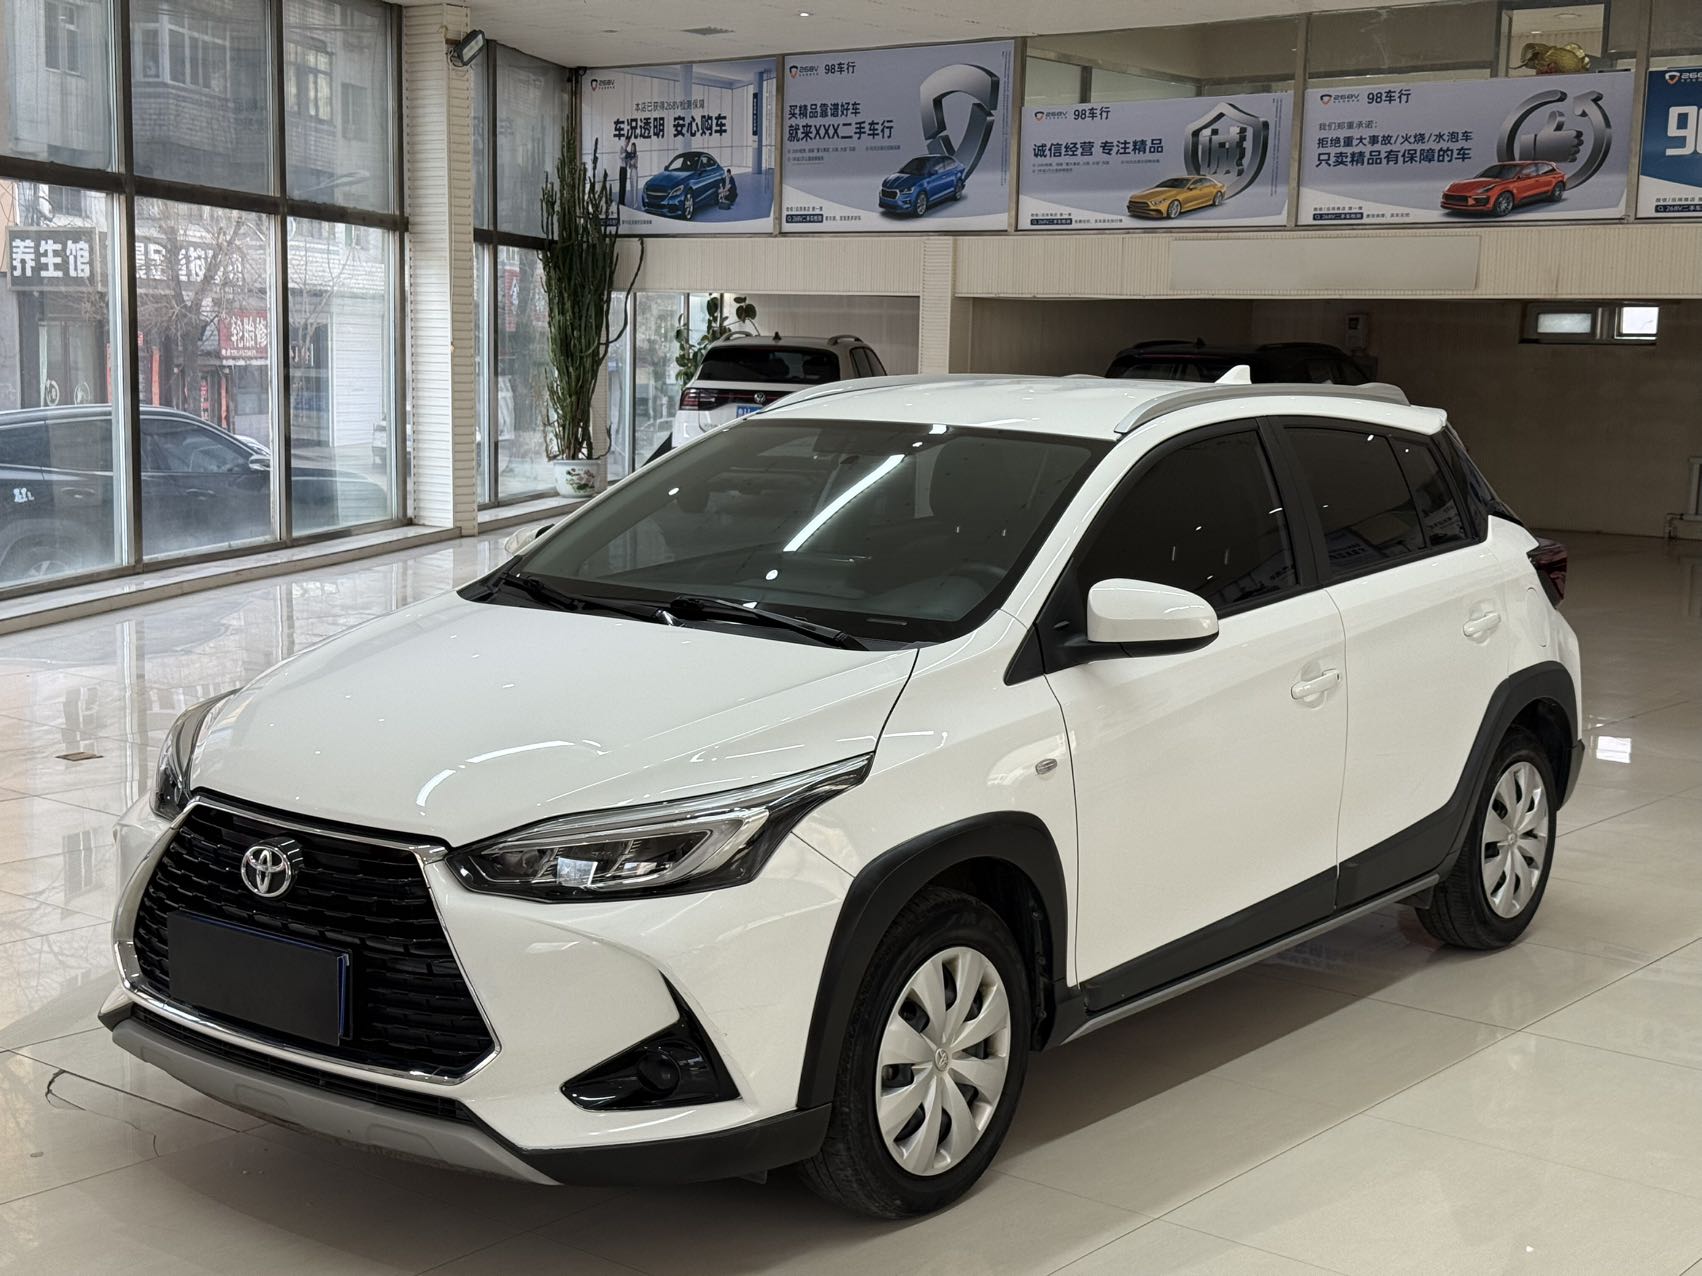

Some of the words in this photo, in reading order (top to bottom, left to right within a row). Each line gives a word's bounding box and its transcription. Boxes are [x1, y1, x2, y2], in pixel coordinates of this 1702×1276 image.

[824, 61, 857, 75] 98车行
[1367, 88, 1411, 104] 98车行
[787, 101, 861, 120] 买精品靠谱好车
[1073, 106, 1111, 121] 98车行
[613, 116, 665, 140] 车况透明
[672, 113, 728, 138] 安心购车
[787, 119, 894, 142] 就来XXX二手车行
[1665, 105, 1702, 156] 9
[1033, 141, 1095, 158] 诚信经营
[1100, 138, 1164, 155] 专注精品
[1317, 130, 1473, 149] 拒绝重大事故/火烧/水泡车
[1315, 146, 1472, 168] 只卖精品有保障的车
[12, 239, 90, 278] 养生馆
